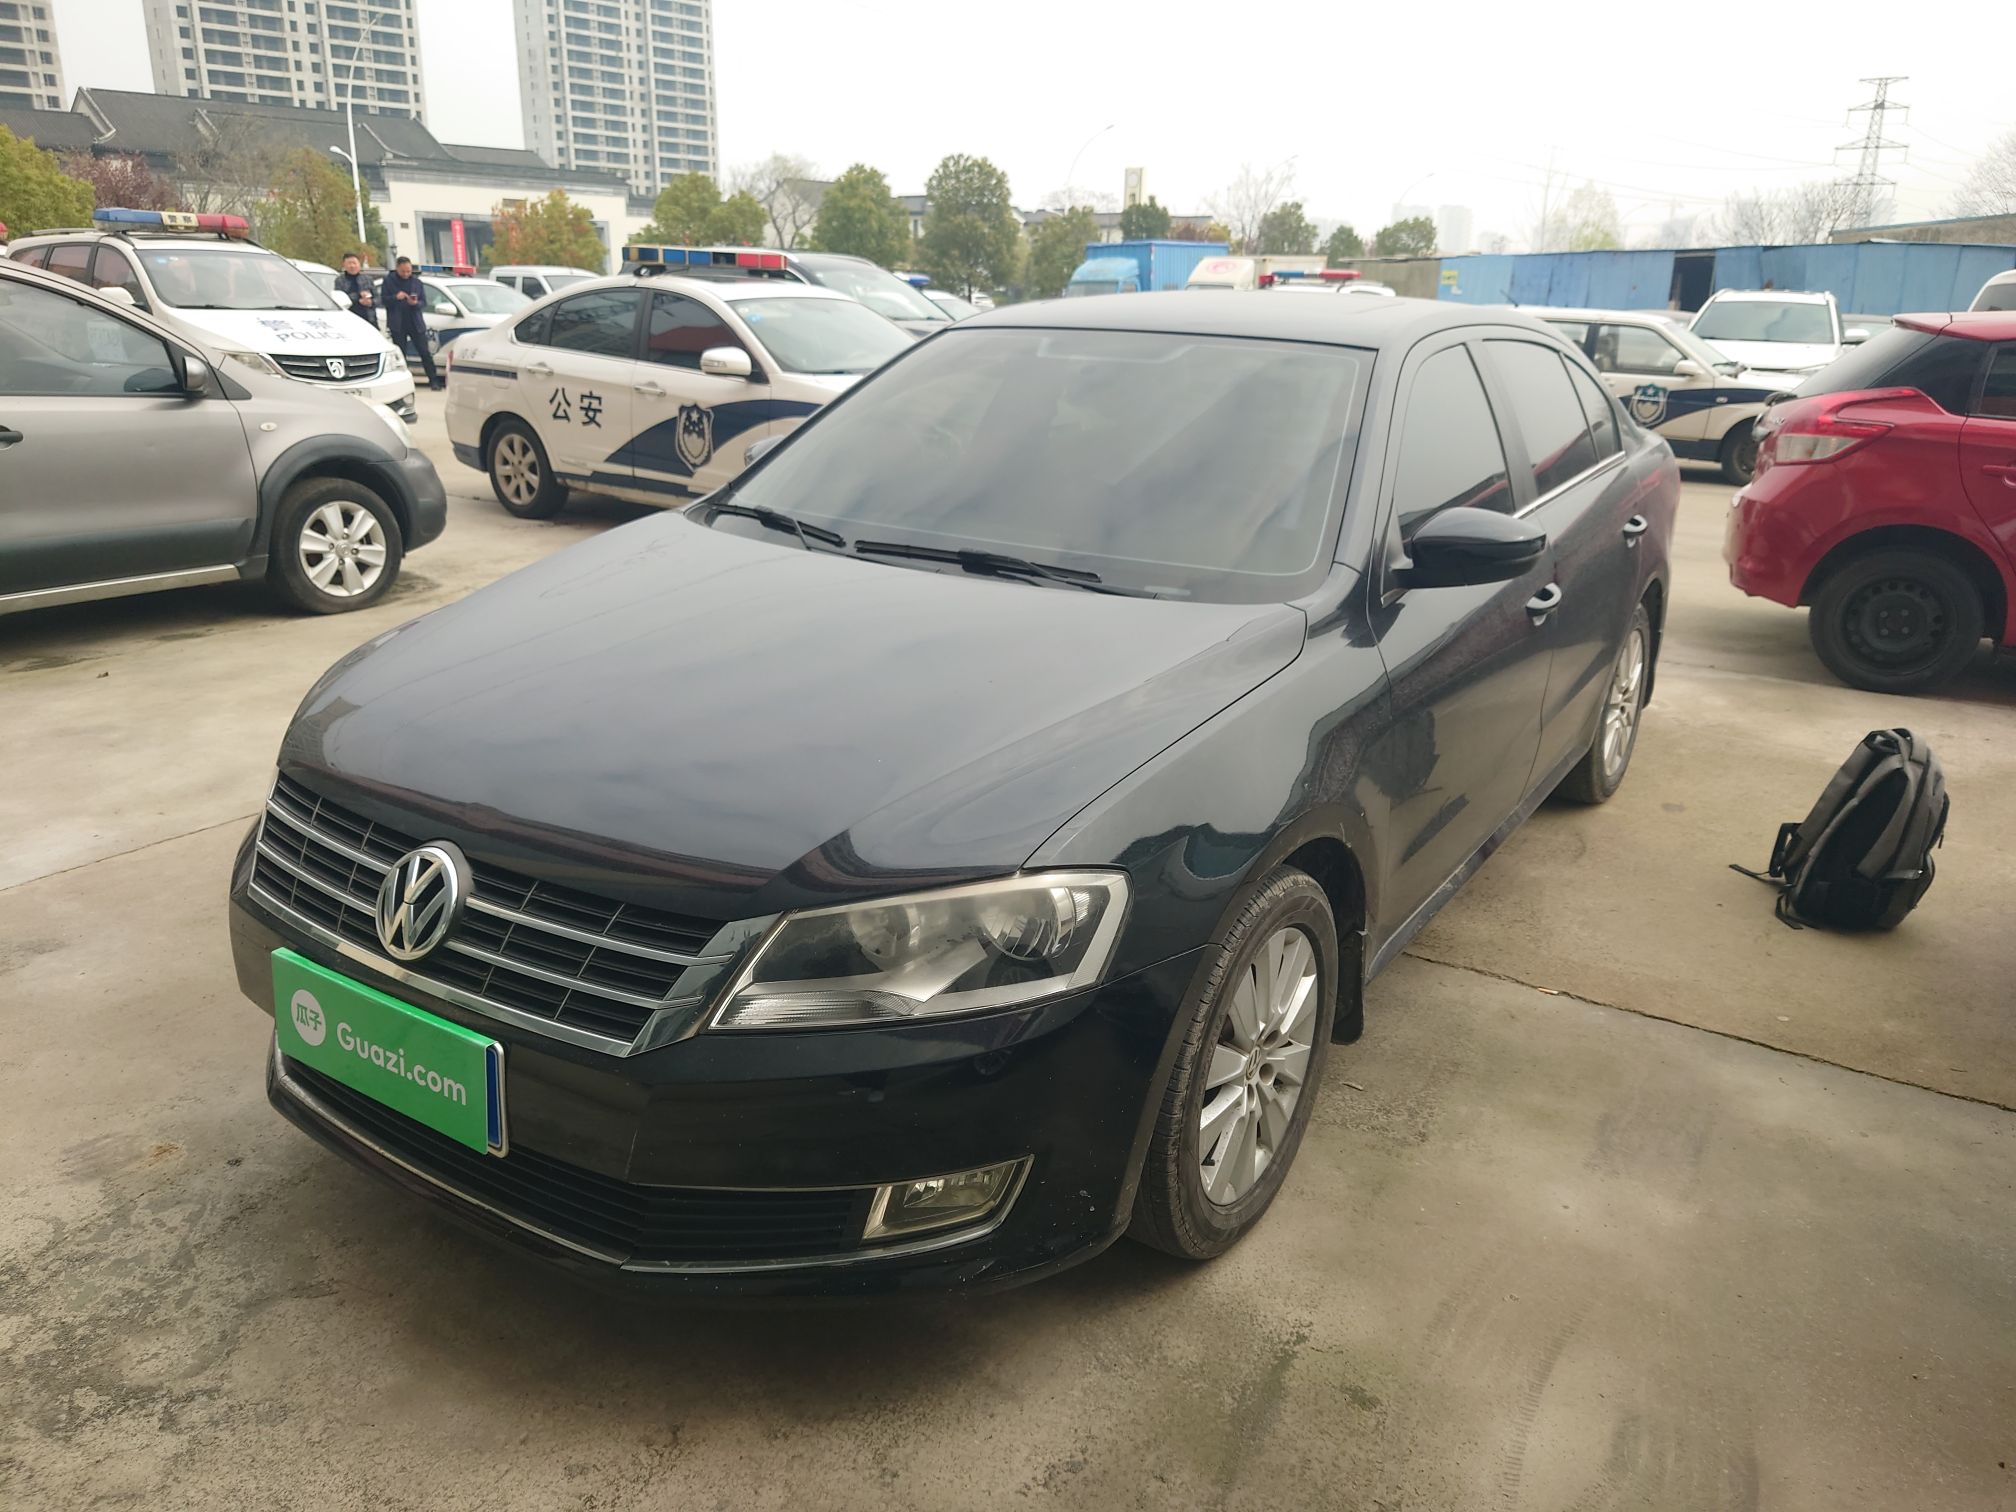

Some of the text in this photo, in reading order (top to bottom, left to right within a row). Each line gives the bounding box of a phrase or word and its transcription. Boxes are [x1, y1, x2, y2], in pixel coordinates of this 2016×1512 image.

[256, 317, 335, 331] 警察
[276, 331, 352, 342] POLICE
[549, 387, 602, 429] 公安
[296, 1002, 322, 1032] 瓜子
[336, 1022, 467, 1106] Guazi.com
